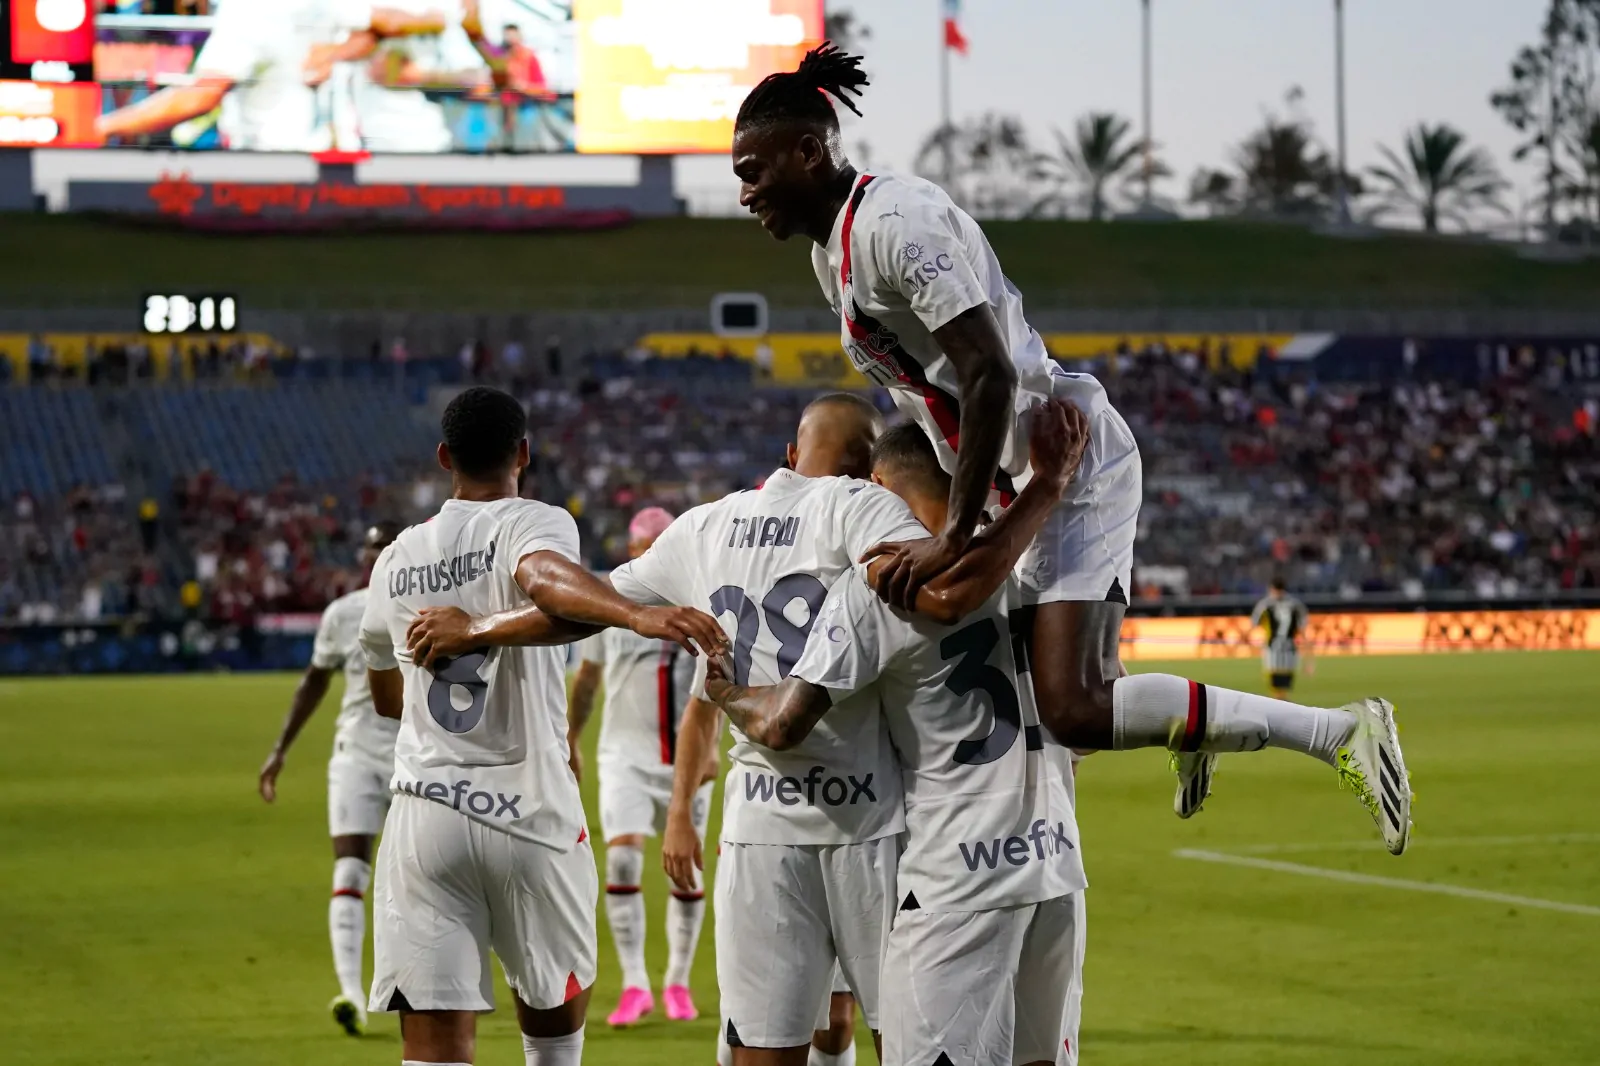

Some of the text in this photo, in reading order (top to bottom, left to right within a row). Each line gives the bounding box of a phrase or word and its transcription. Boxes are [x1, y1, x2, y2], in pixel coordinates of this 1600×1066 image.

[213, 182, 313, 214] Dignity
[318, 183, 410, 207] Health
[416, 183, 501, 212] Sports
[904, 253, 953, 293] MSC
[940, 617, 1020, 765] 3
[397, 780, 522, 818] wefox
[746, 766, 877, 806] wefox
[959, 819, 1074, 871] wefox
